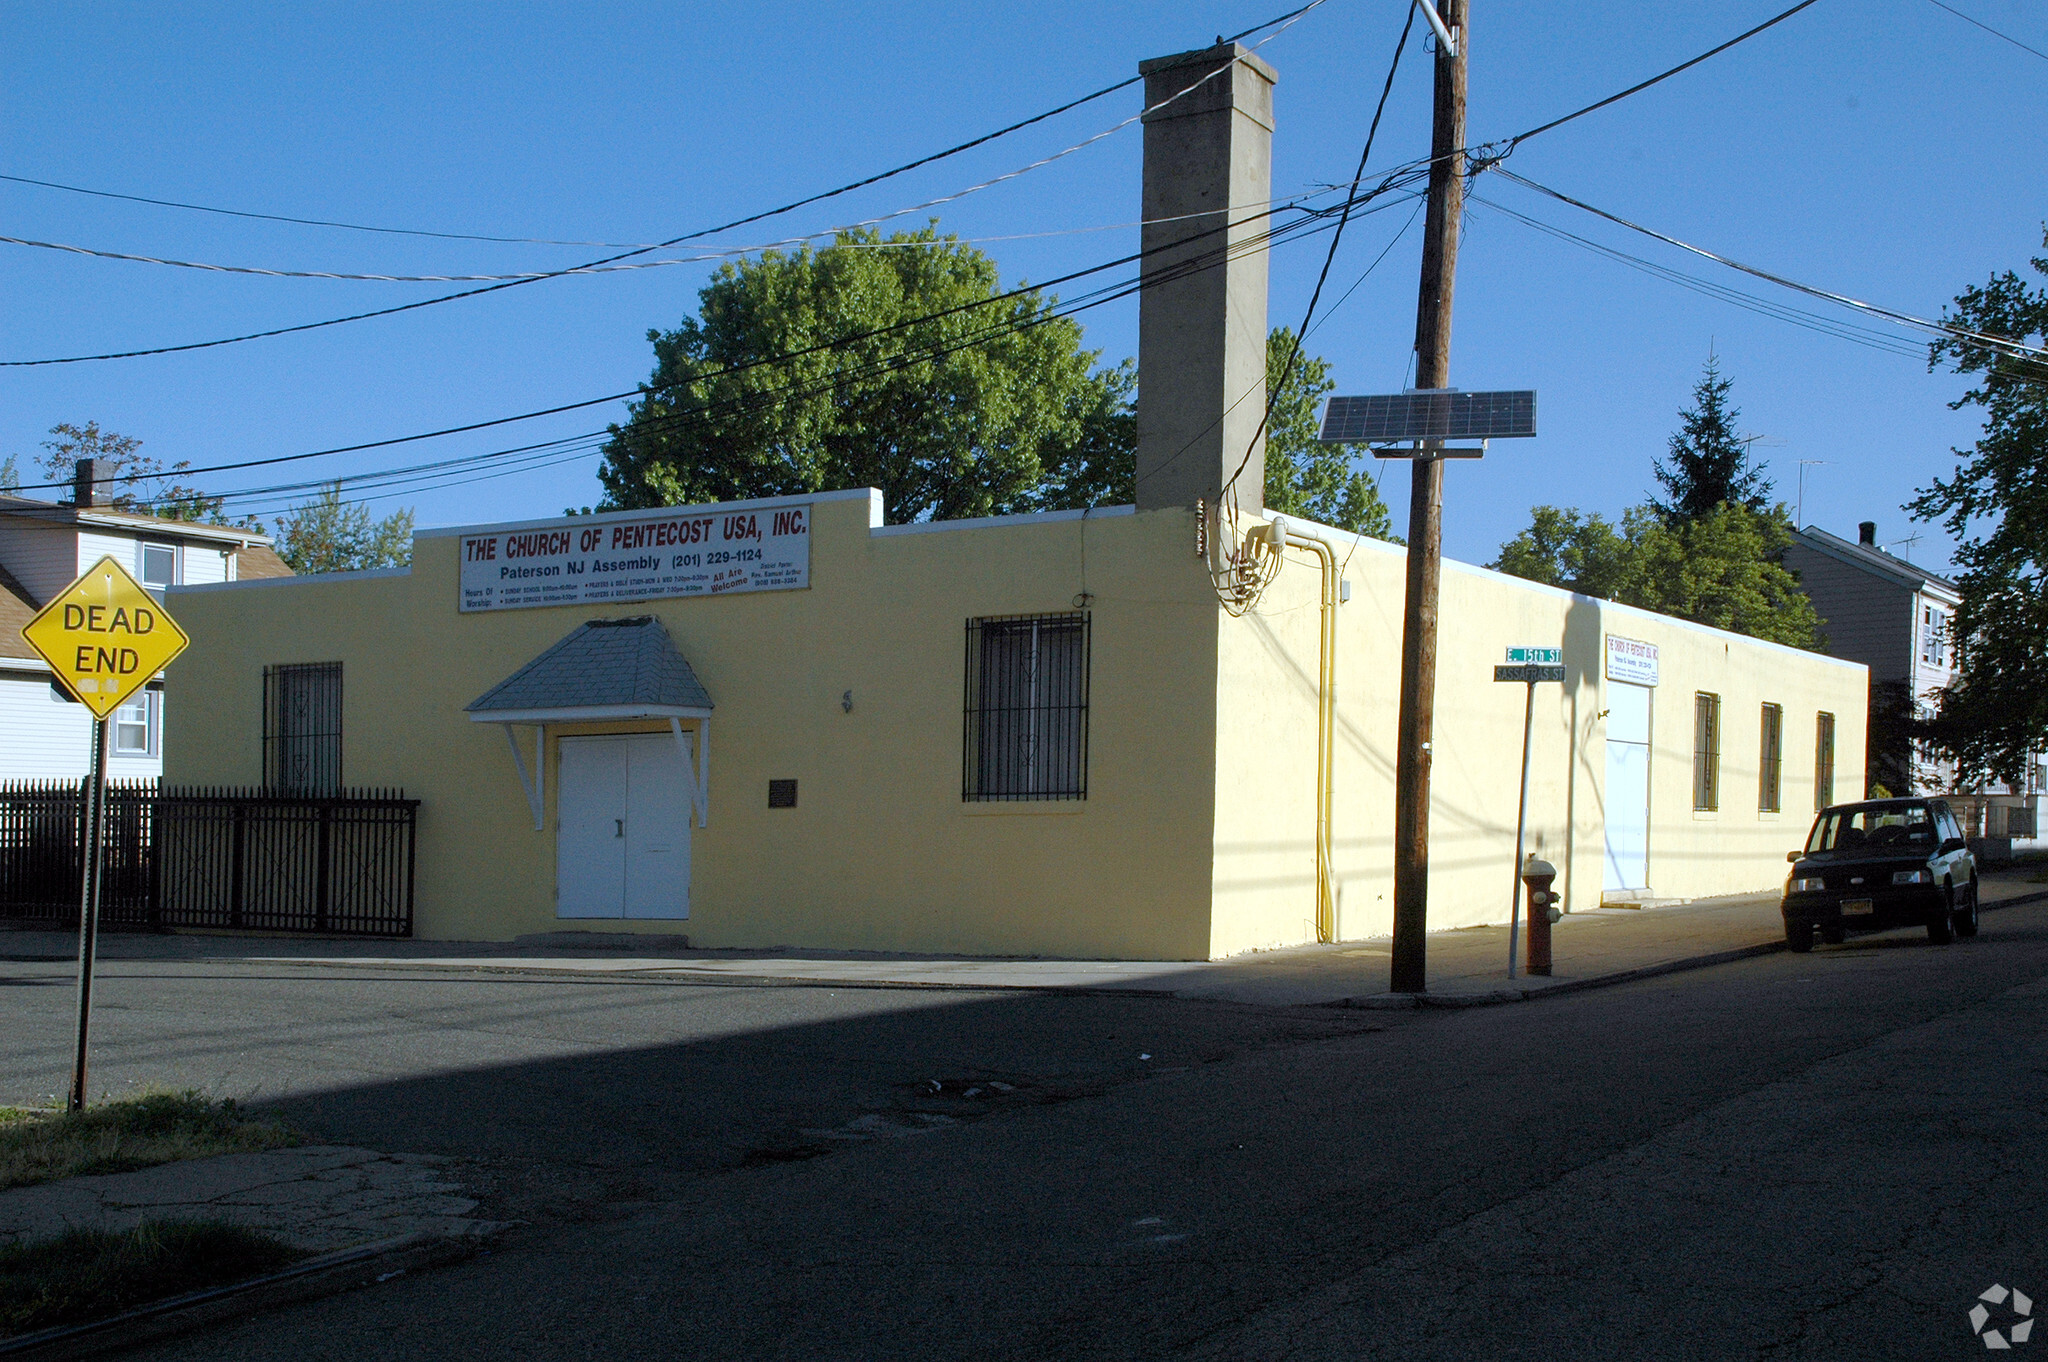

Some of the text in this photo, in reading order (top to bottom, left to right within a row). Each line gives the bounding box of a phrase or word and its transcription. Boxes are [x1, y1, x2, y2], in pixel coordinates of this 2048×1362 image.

[466, 510, 807, 561] THE CHURCH OF PENTECOST USA, INC.
[500, 549, 762, 580] Paterson NJ Assembly (201) 229-1124
[714, 568, 743, 583] All Are
[710, 577, 748, 593] Welcome
[465, 589, 483, 598] Hours
[64, 603, 155, 634] DEAD
[75, 645, 139, 674] END
[1507, 649, 1561, 662] E. 15th ST
[1496, 667, 1564, 681] SASSAFRAS ST
